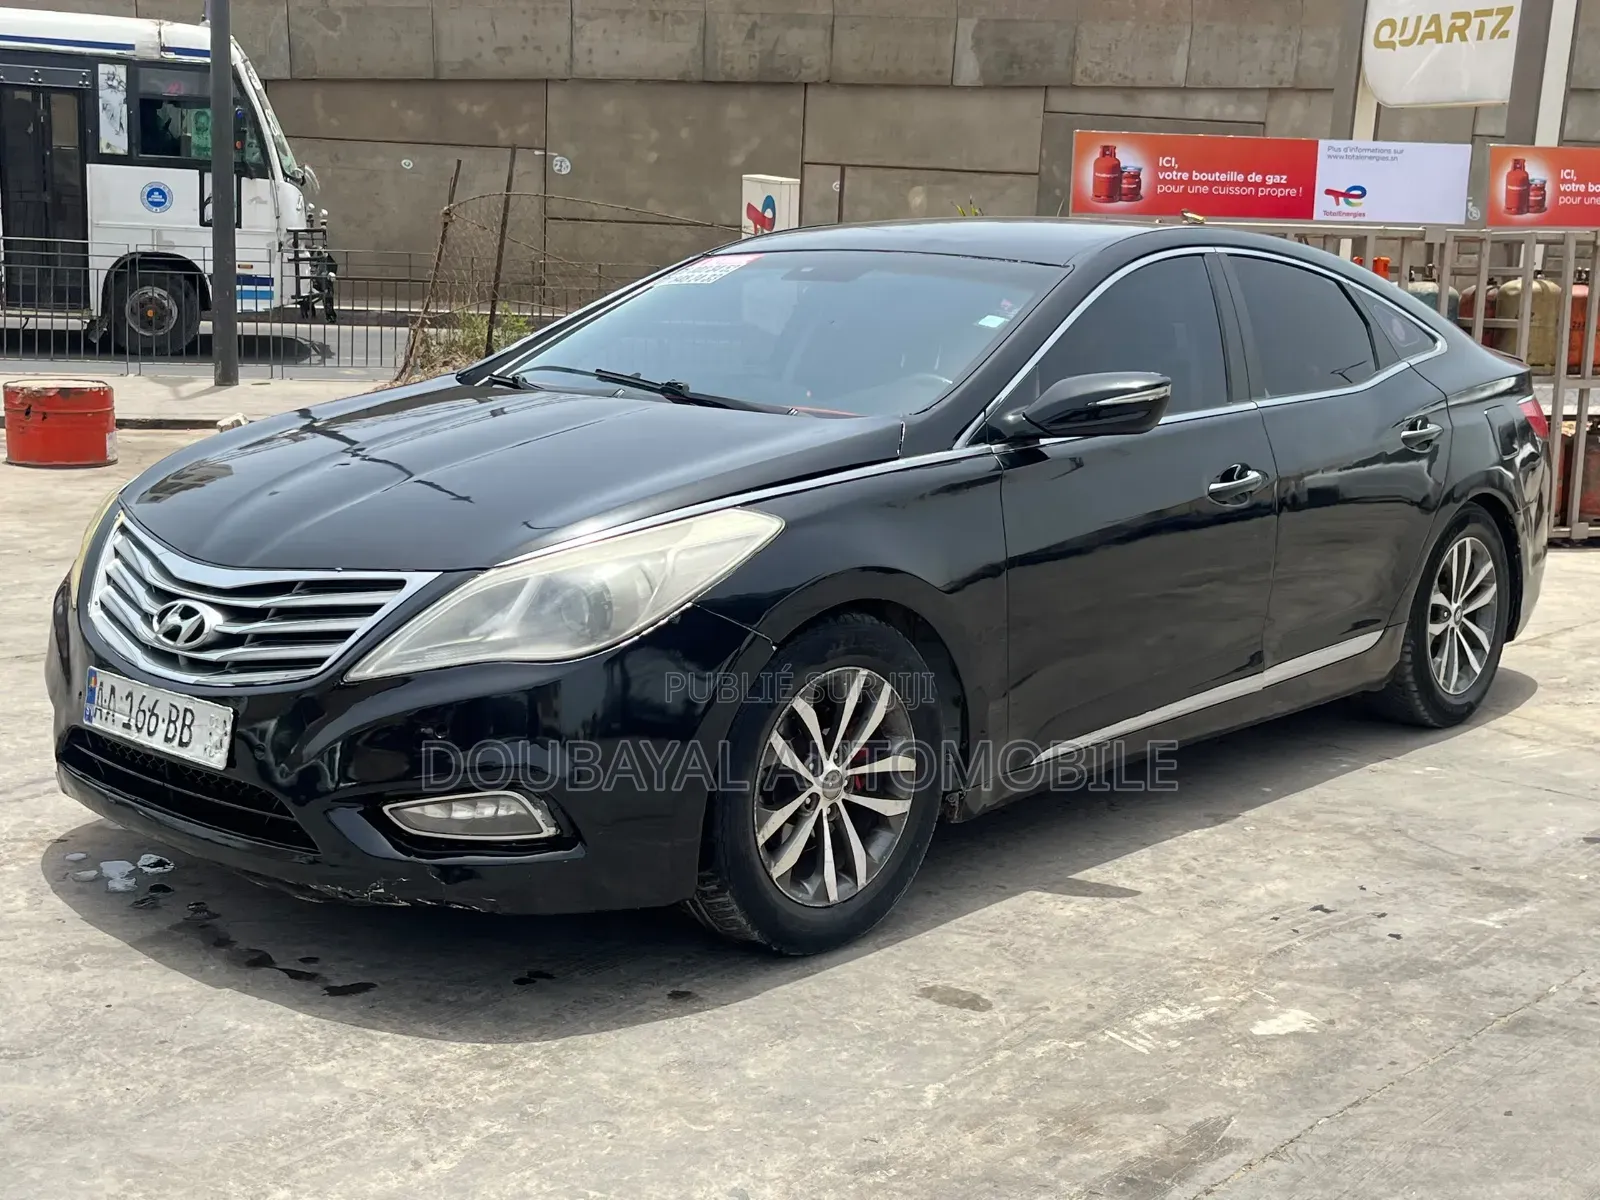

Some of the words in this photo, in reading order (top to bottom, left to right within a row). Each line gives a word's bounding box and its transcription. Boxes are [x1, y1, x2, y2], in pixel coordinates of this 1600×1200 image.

[1373, 6, 1514, 51] QUARTZ
[1159, 157, 1178, 168] ICI,
[1158, 171, 1189, 181] votre
[1192, 171, 1244, 182] bouteille
[1247, 172, 1262, 183] de
[1265, 175, 1287, 185] gaz
[1560, 169, 1577, 181] ICI,
[1157, 184, 1184, 195] pour
[1187, 186, 1209, 194] une
[1212, 185, 1254, 196] cuisson
[1559, 182, 1586, 192] votre
[1558, 195, 1582, 206] pour
[1323, 210, 1366, 218] TotalEnergies
